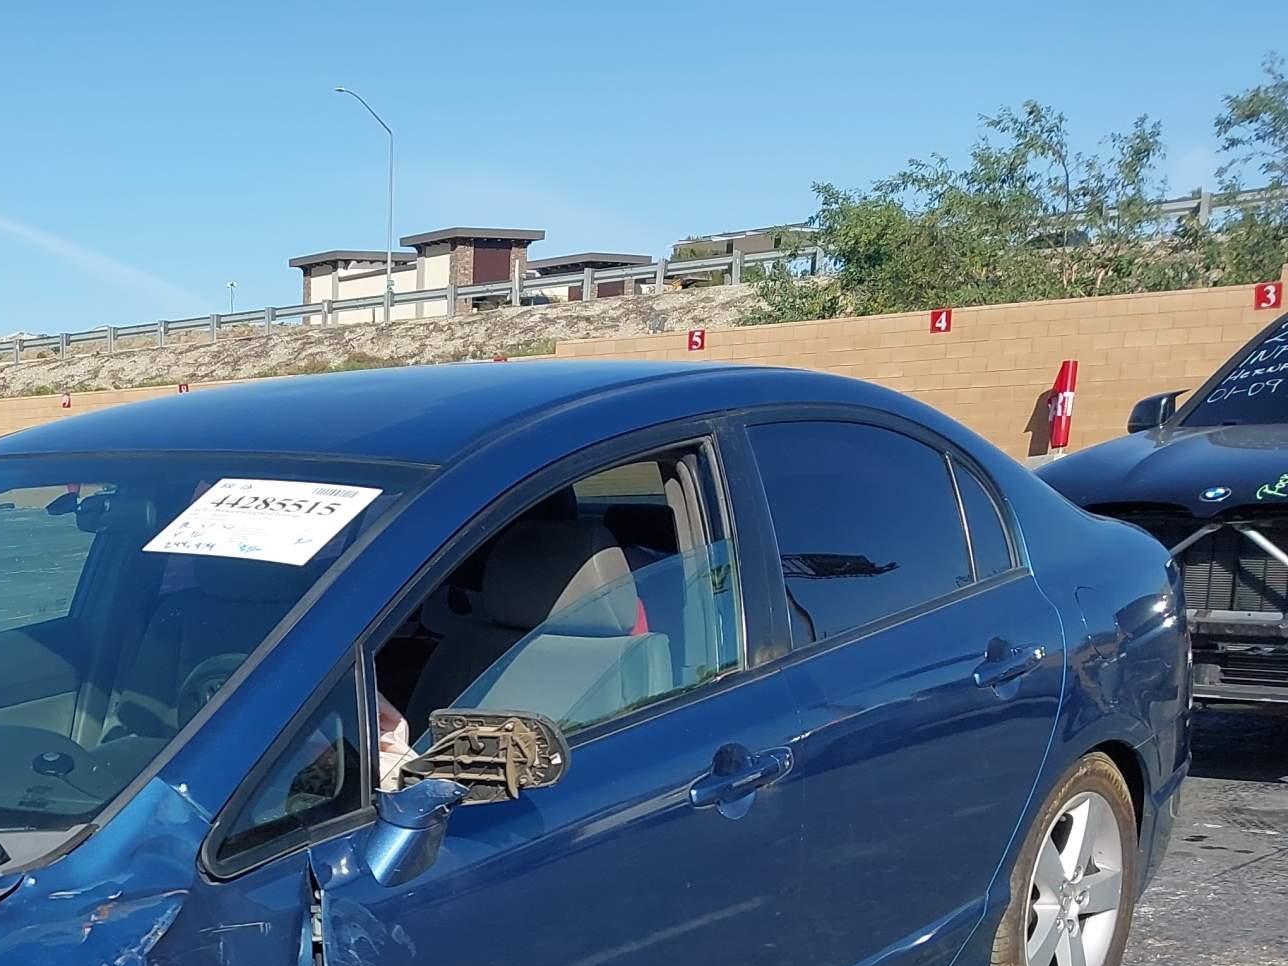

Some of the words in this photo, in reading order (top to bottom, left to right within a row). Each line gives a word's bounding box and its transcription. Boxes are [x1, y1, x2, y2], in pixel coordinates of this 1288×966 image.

[1261, 285, 1276, 307] 3
[935, 311, 947, 331] 4
[692, 331, 702, 349] 5
[210, 494, 342, 516] 44285515
